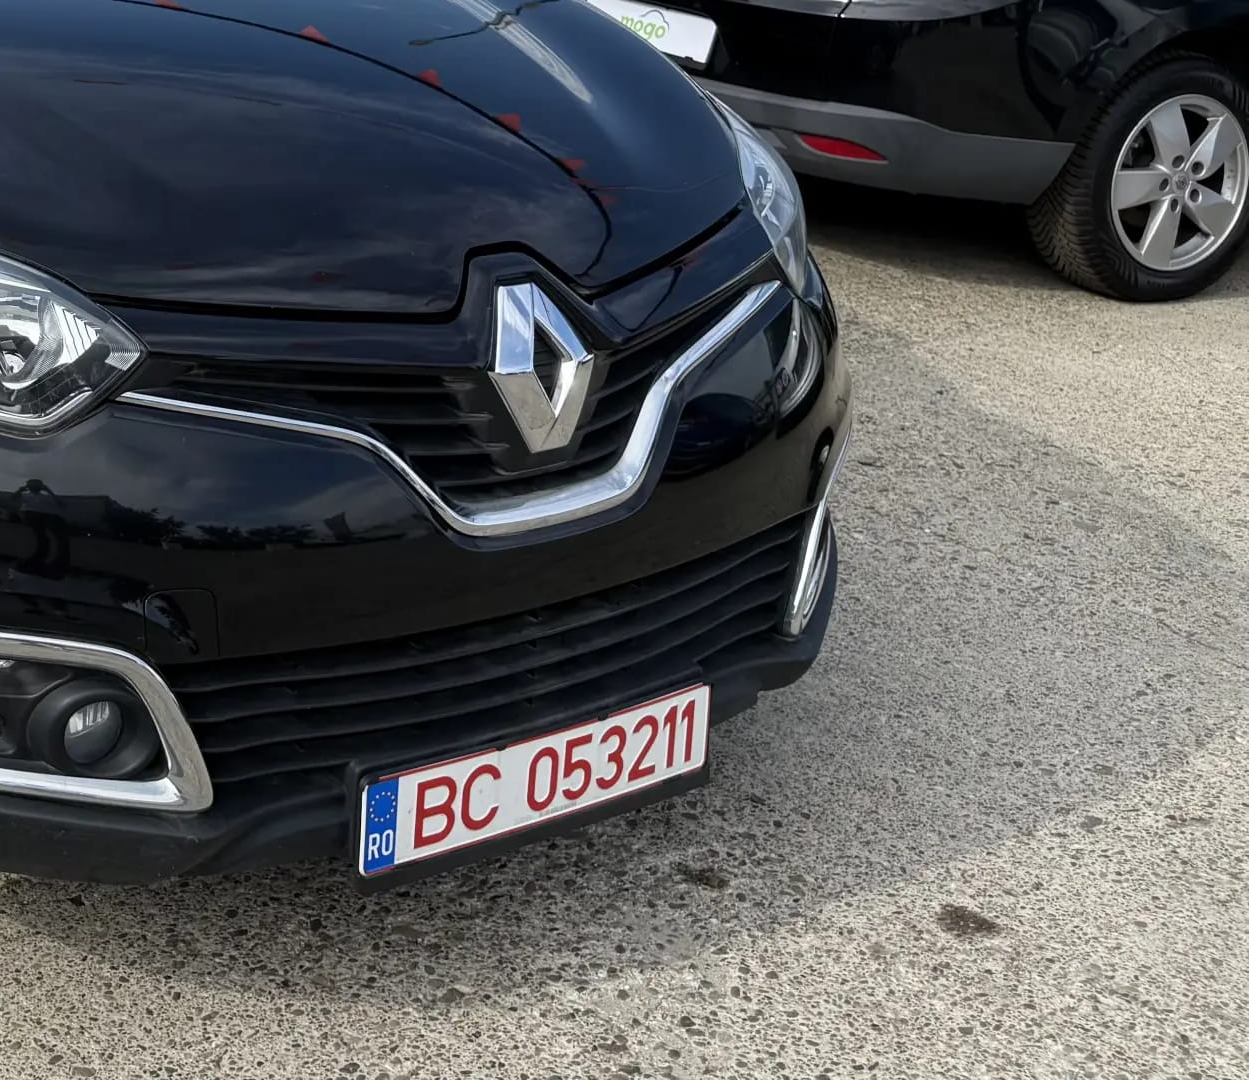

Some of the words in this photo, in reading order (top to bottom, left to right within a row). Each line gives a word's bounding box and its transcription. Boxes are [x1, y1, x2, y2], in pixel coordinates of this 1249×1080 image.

[621, 15, 666, 40] mogo
[413, 764, 502, 849] BC
[526, 699, 696, 812] 053211
[367, 829, 395, 861] RO
